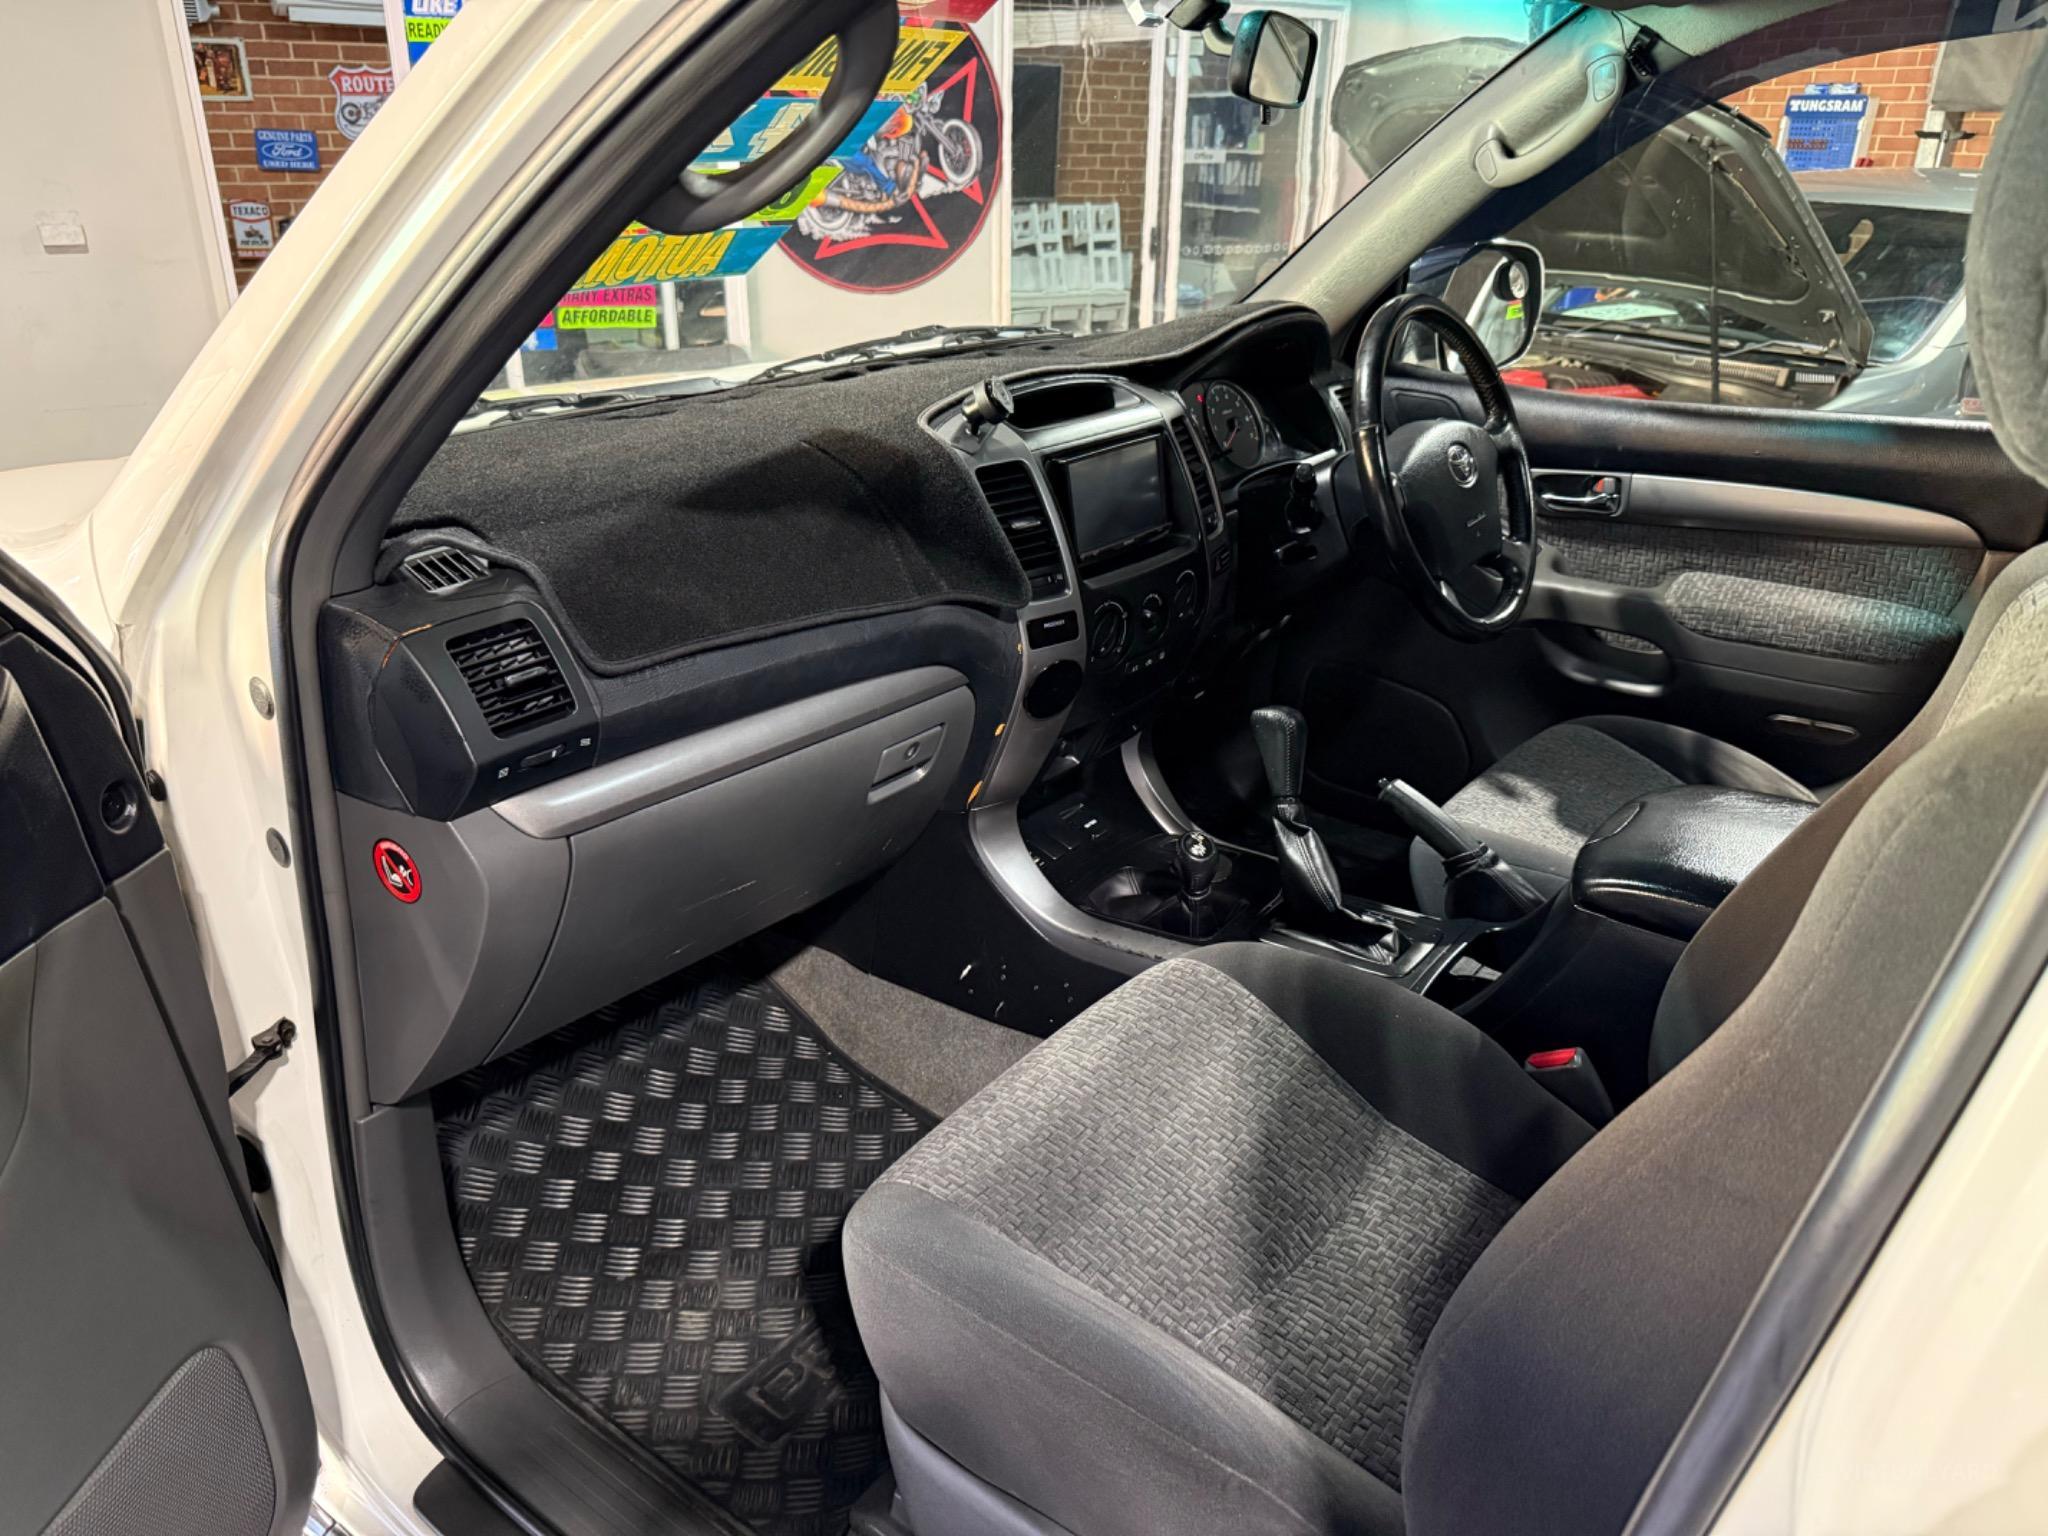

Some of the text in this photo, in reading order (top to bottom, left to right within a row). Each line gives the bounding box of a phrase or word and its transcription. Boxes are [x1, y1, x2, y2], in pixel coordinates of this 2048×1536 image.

[408, 22, 446, 38] READ
[341, 75, 394, 93] ROUTE
[1789, 99, 1864, 112] TUNGSRAM
[271, 142, 303, 157] Ford
[233, 205, 268, 216] TEXACO
[603, 286, 652, 302] EXTRAS
[562, 309, 653, 325] AFFORDABLE
